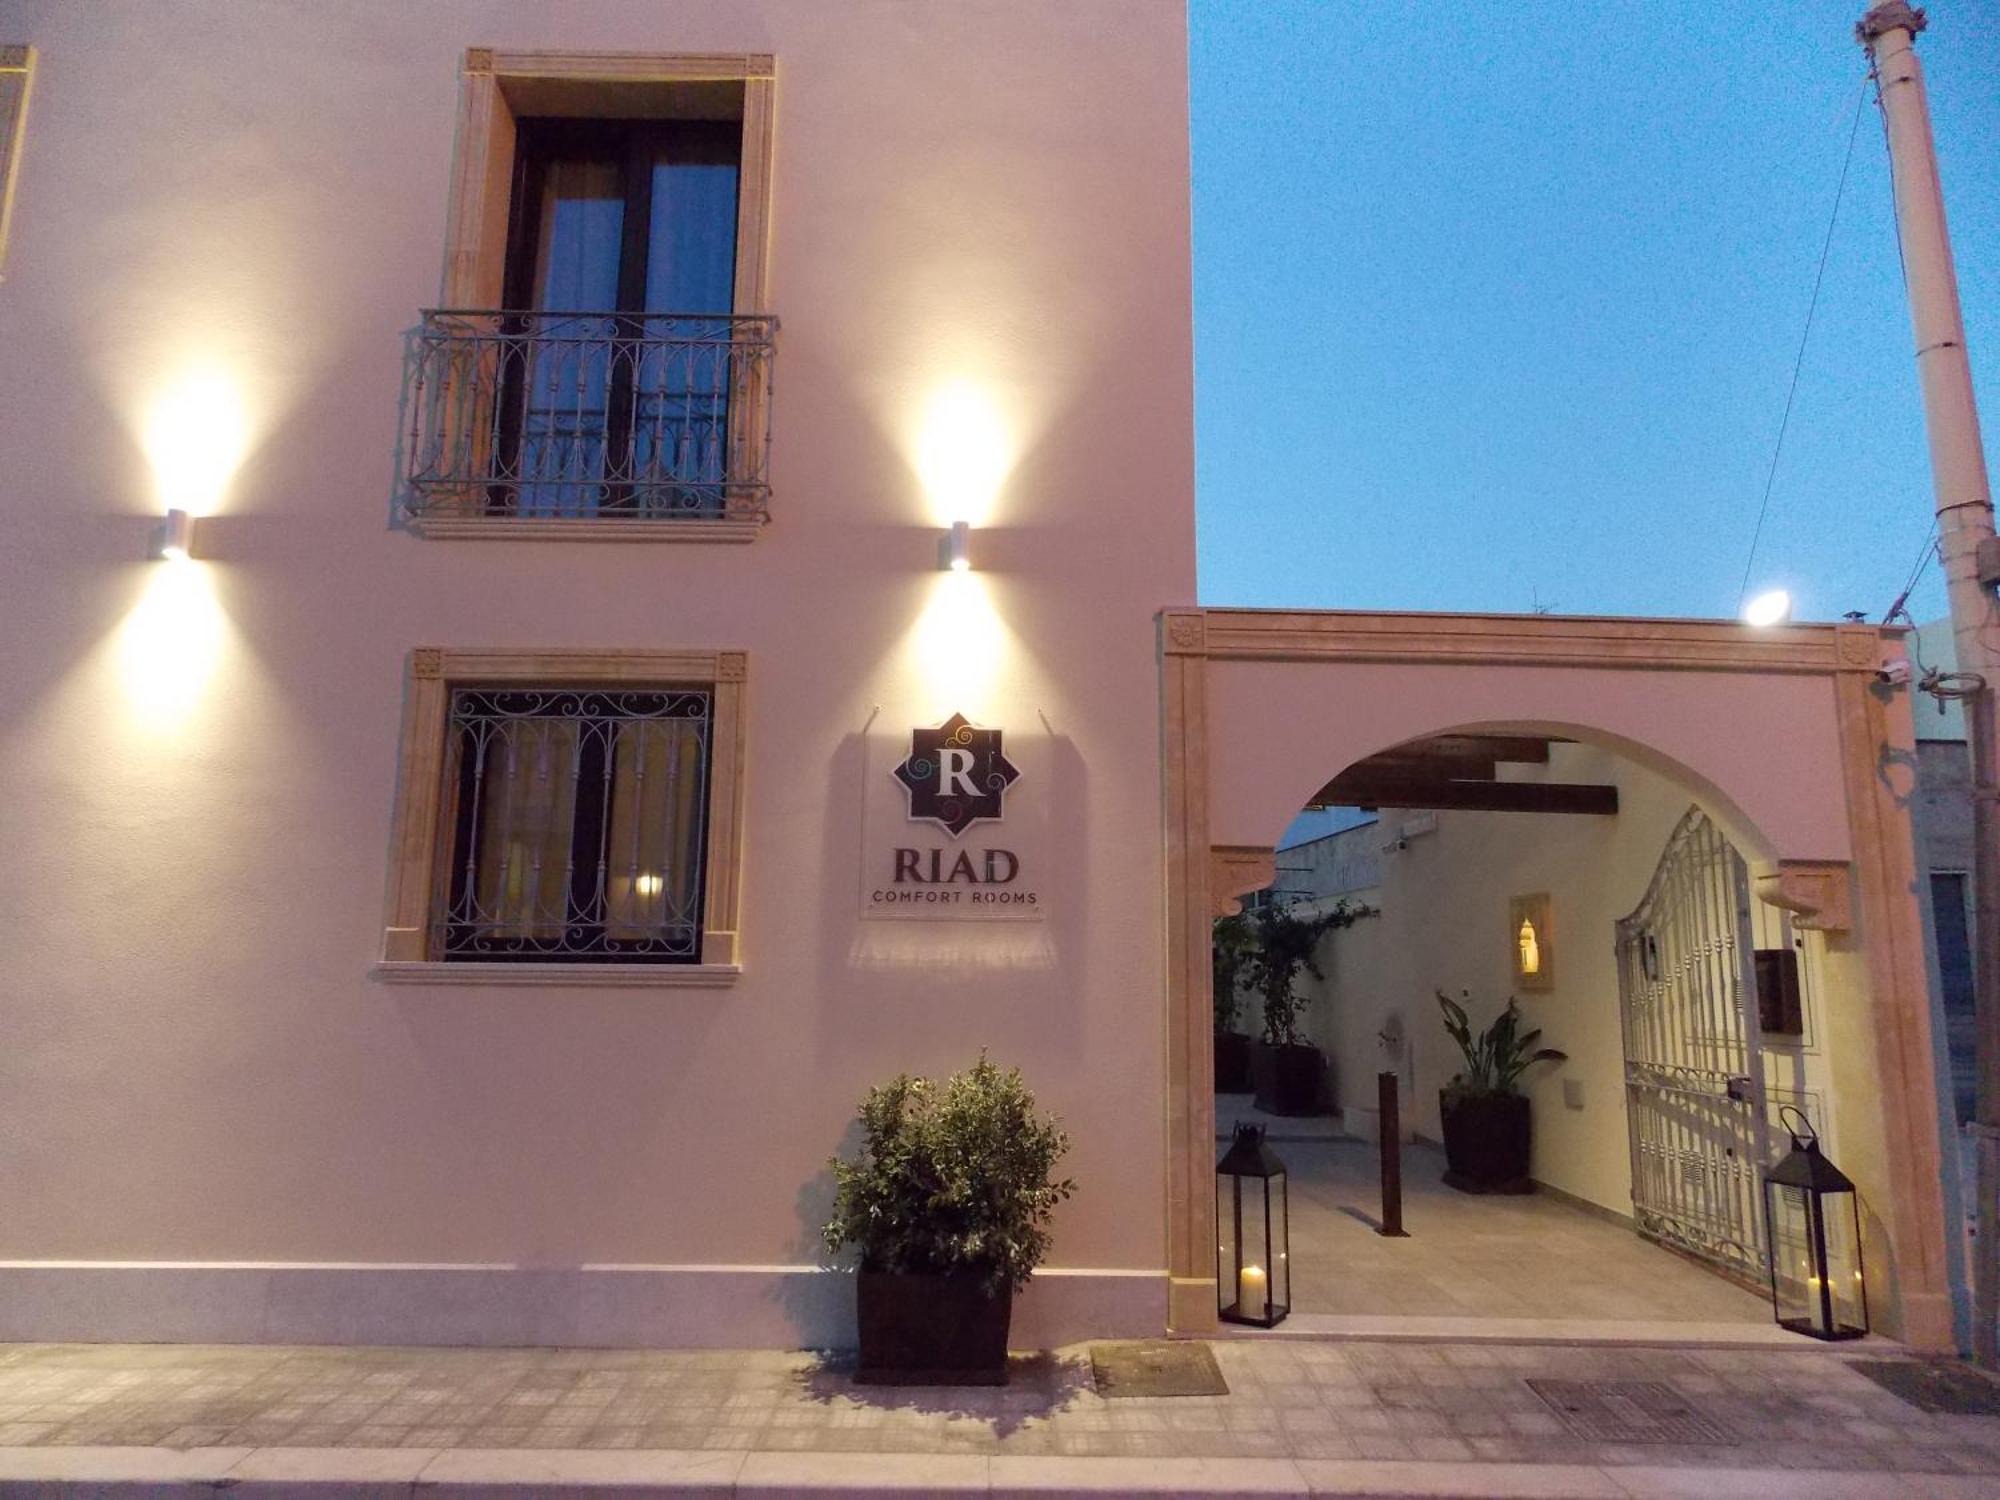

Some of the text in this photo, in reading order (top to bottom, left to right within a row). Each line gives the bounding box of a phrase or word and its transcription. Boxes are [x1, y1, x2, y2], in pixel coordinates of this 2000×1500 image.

[935, 748, 987, 797] R
[893, 848, 1019, 884] RIAD
[872, 890, 1037, 904] COMFORT ROOMS
